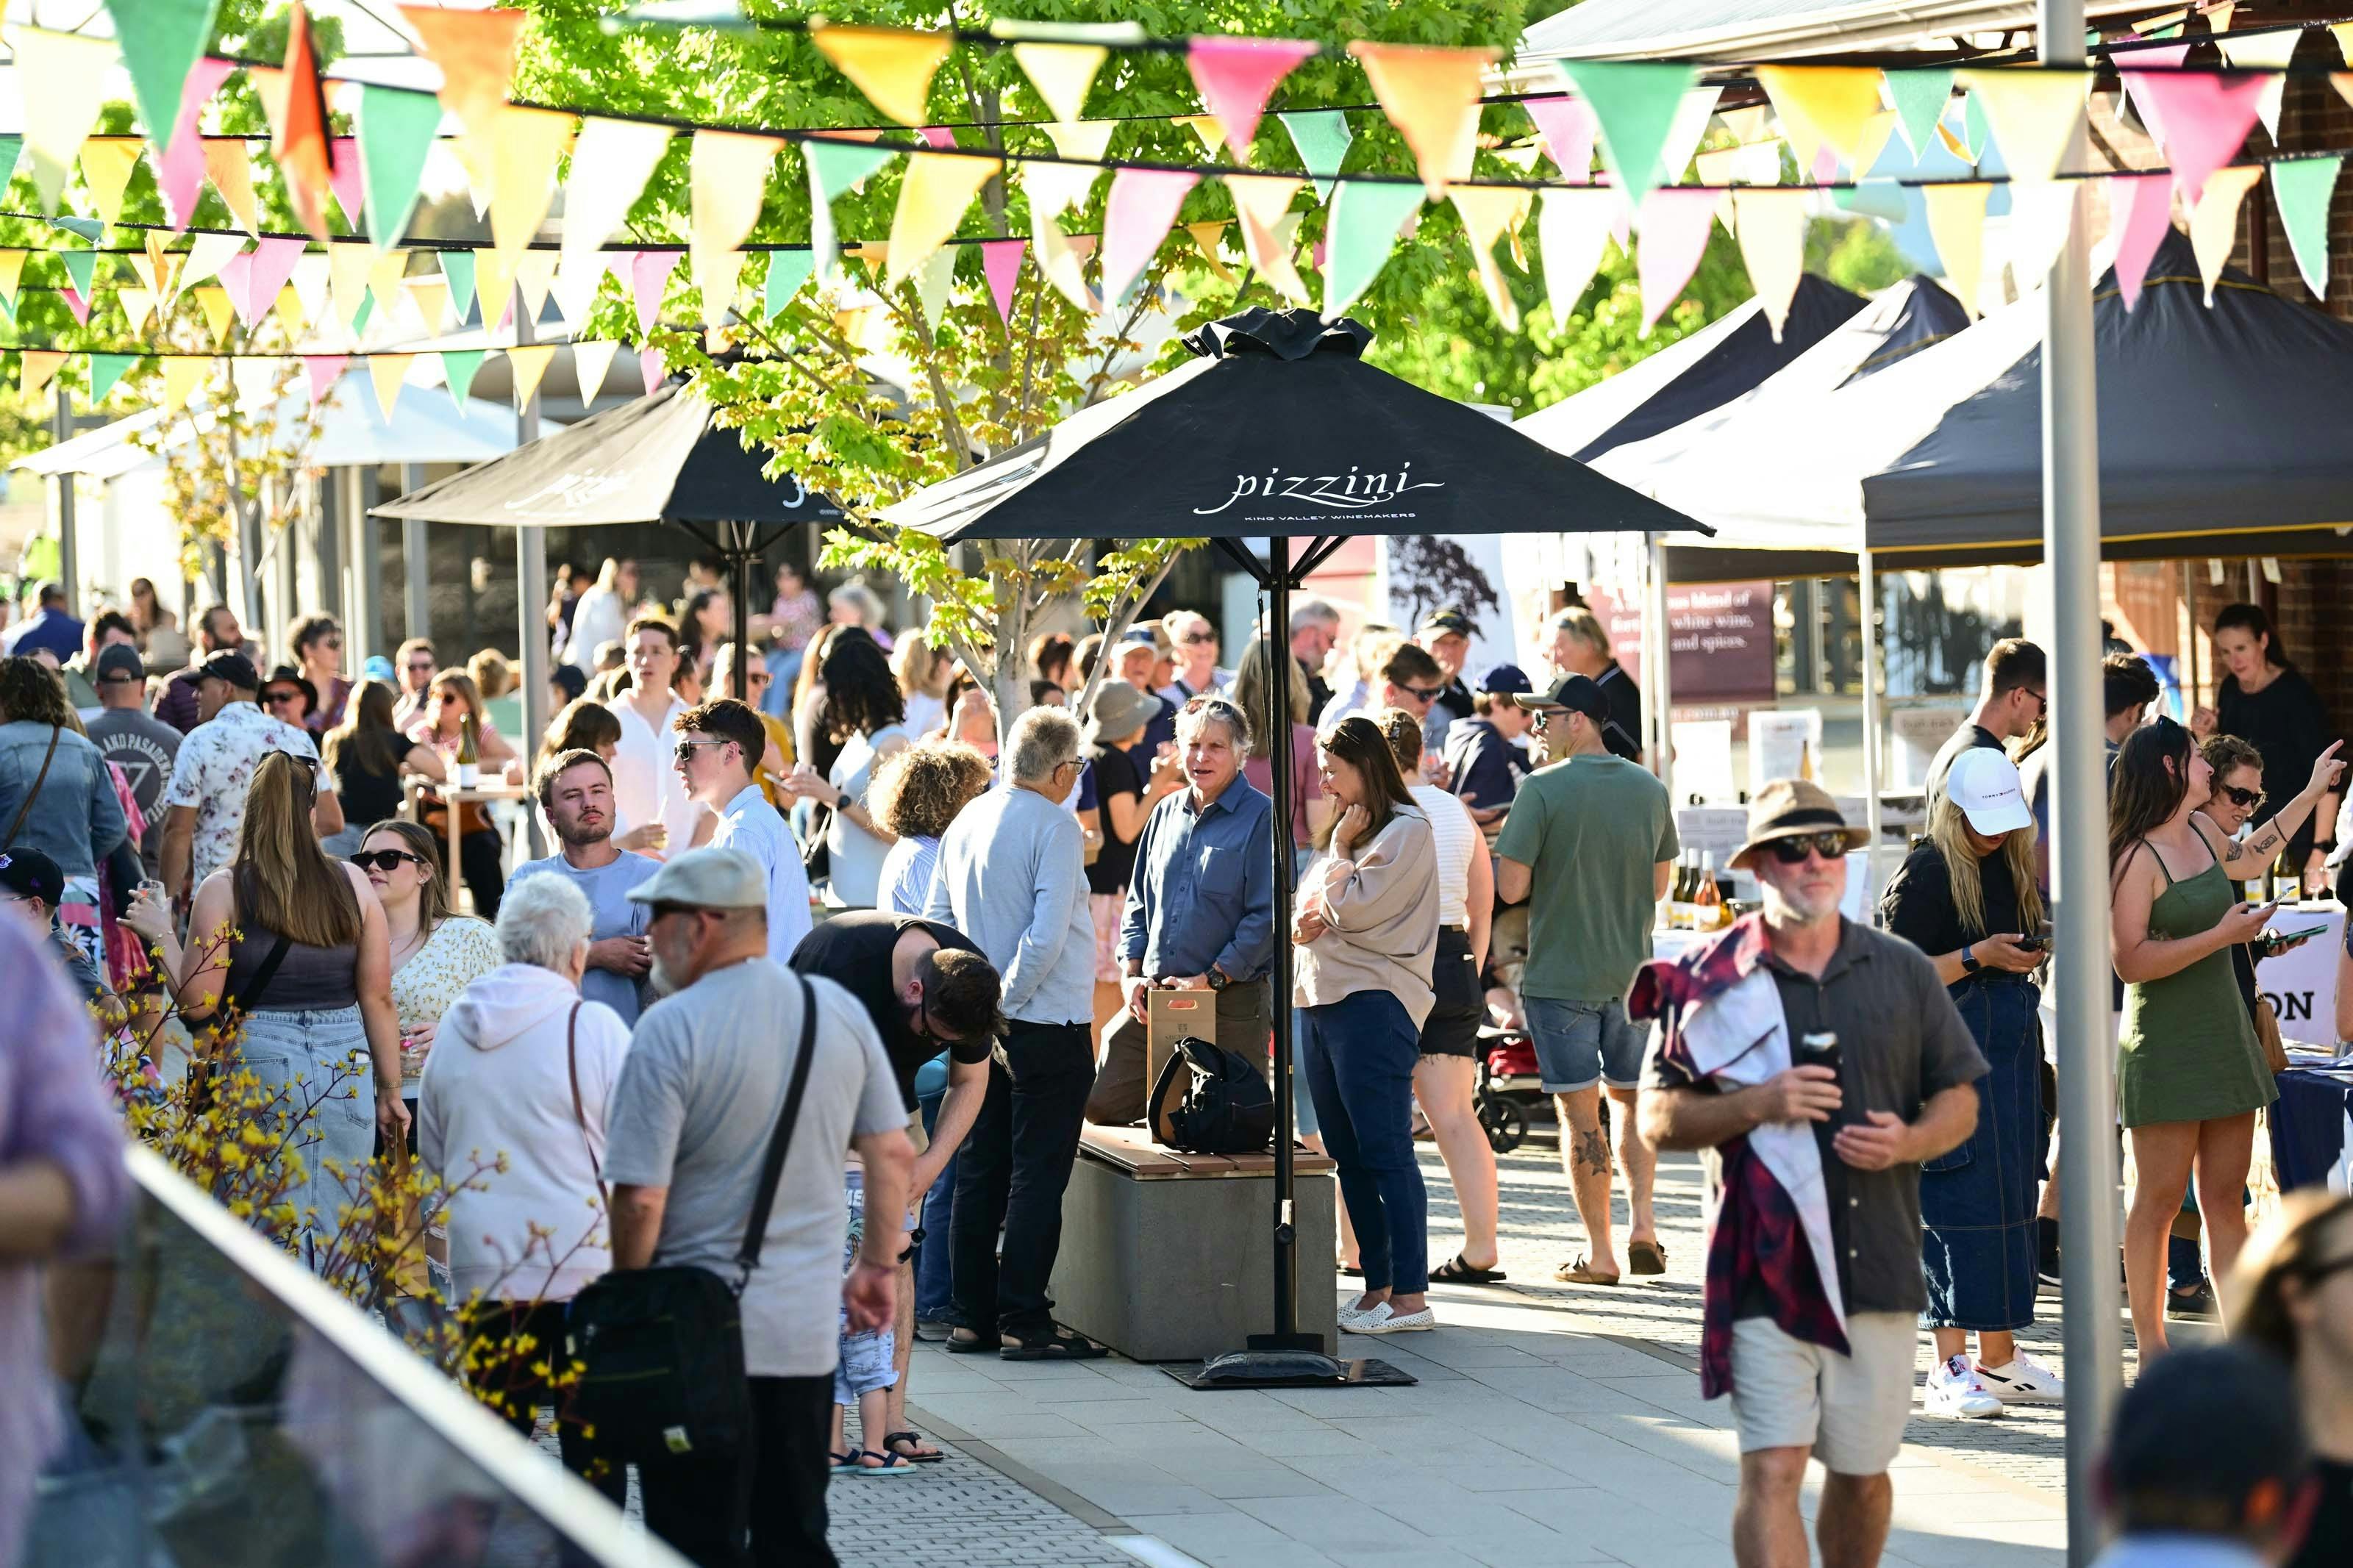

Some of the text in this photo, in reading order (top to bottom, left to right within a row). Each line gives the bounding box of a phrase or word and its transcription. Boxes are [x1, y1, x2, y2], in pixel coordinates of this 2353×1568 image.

[1193, 462, 1445, 515] pizzini
[1330, 512, 1417, 520] WINEMAKERS
[1671, 634, 1699, 652] and
[103, 733, 127, 753] AND
